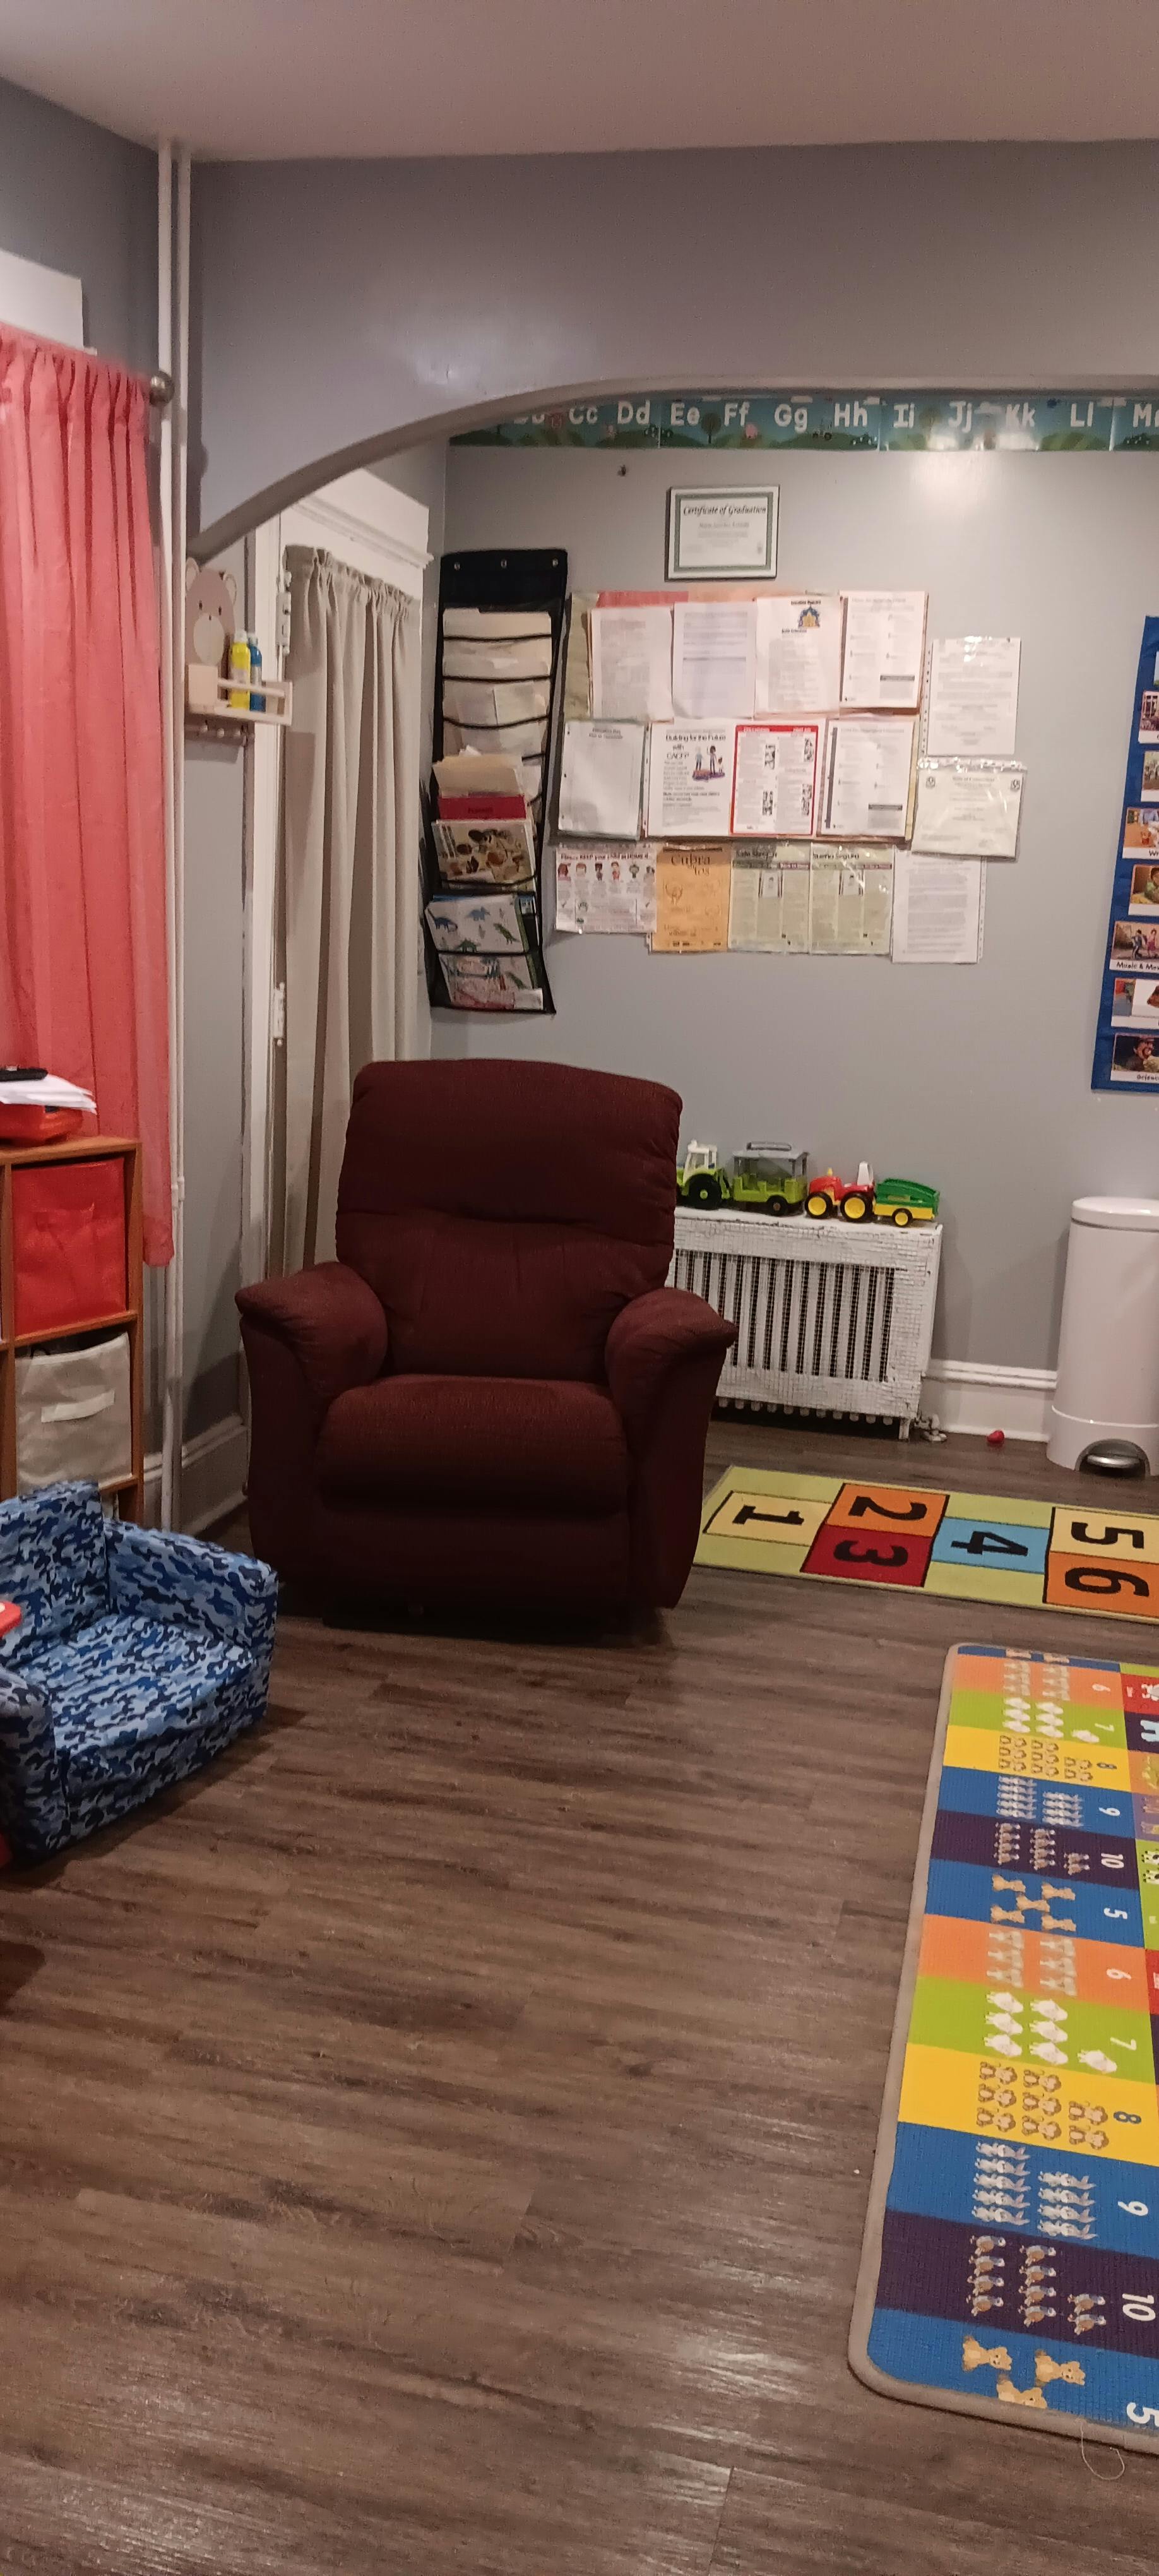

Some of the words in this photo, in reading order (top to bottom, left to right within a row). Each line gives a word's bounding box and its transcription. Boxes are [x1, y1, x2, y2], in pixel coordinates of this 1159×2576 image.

[617, 400, 650, 425] Dd
[670, 402, 701, 426] Ee
[723, 402, 750, 426] Ff
[774, 404, 809, 432] Gg
[833, 401, 868, 427] Hh
[893, 403, 915, 428] Ii
[948, 401, 972, 432] Jj
[1004, 403, 1036, 427] Kk
[1070, 402, 1093, 427] Ll
[683, 504, 718, 517] Certificate
[719, 504, 726, 515] of
[728, 503, 766, 517] Graduation
[1116, 961, 1138, 970] Music
[732, 1504, 804, 1526] 1
[849, 1496, 927, 1520] 2
[951, 1530, 1029, 1556] 4
[1071, 1522, 1144, 1549] 5
[834, 1540, 908, 1567] 3
[1064, 1566, 1150, 1597] 6
[1095, 1722, 1115, 1732] 7
[1097, 1762, 1117, 1770] 8
[1098, 1806, 1120, 1817] 9
[1100, 1852, 1124, 1869] 10
[1103, 1907, 1128, 1920] 5
[1106, 1968, 1132, 1980] 6
[1110, 2036, 1137, 2051] 7
[1113, 2110, 1142, 2125] 8
[1117, 2199, 1148, 2217] 9
[1121, 2294, 1156, 2322] 10
[1126, 2402, 1159, 2427] 5
